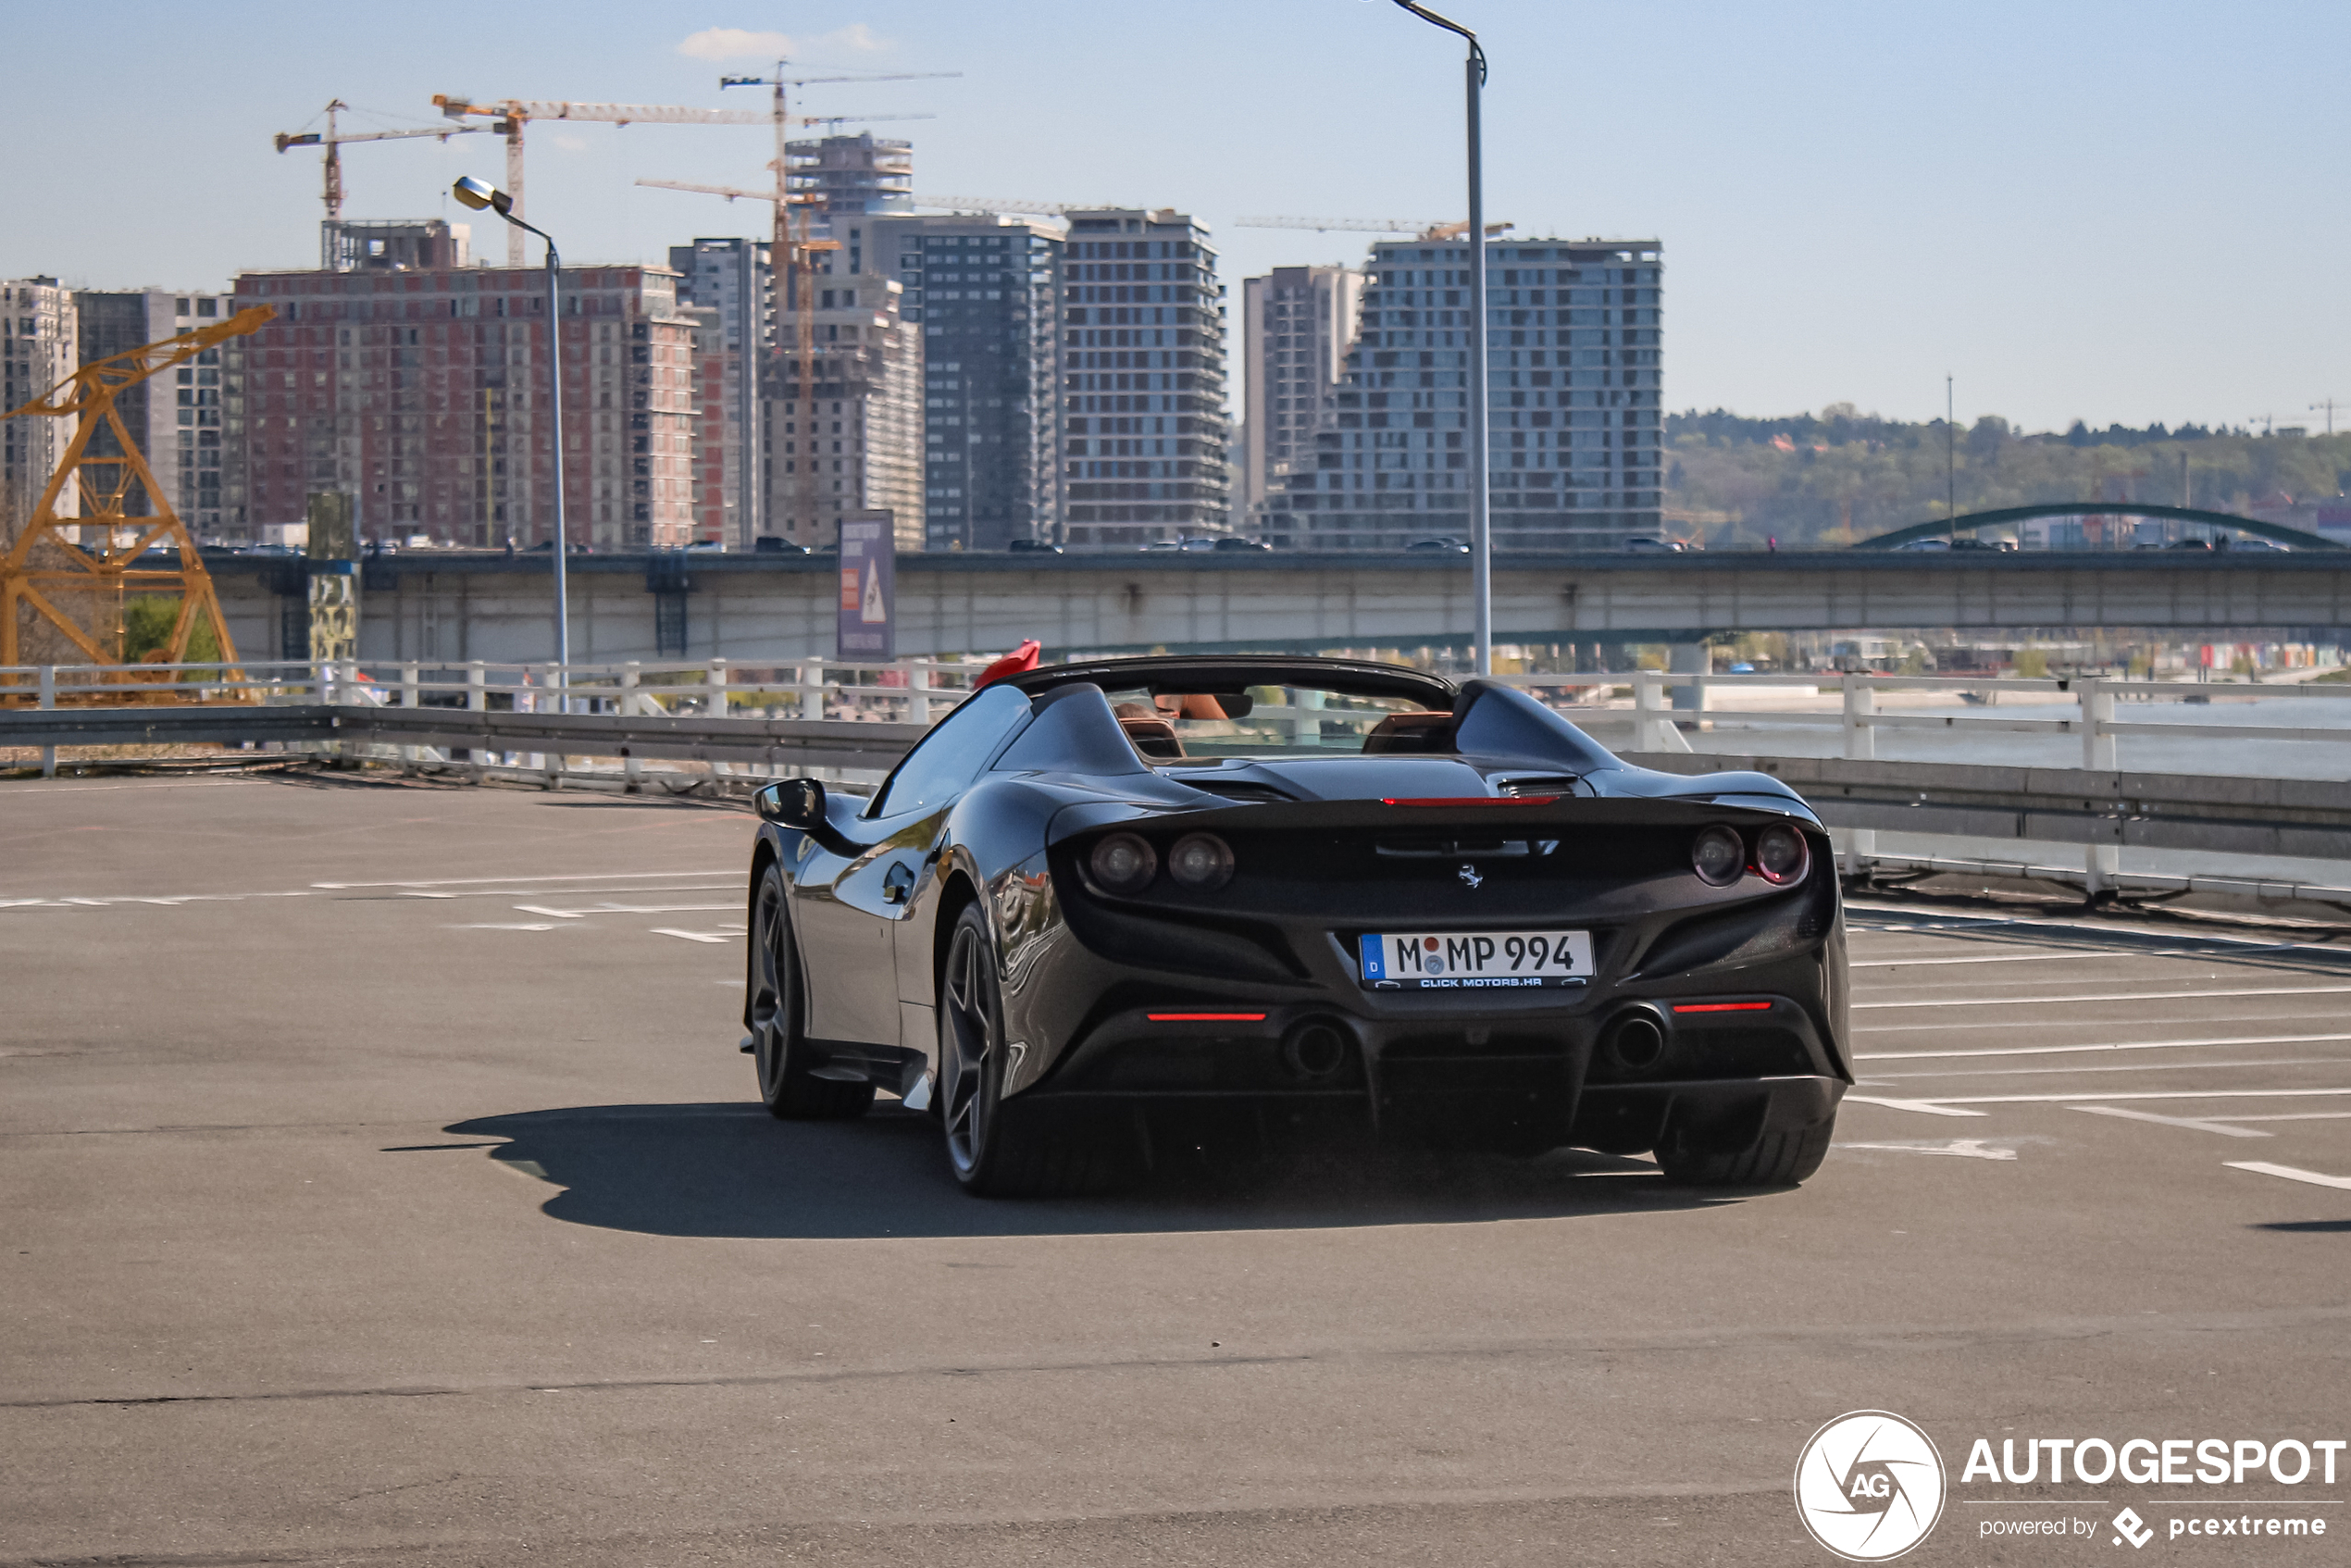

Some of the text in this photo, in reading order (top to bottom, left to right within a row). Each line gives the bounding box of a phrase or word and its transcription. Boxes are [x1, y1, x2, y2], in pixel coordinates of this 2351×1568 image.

[1397, 936, 1574, 972] M MP 994
[1370, 962, 1378, 972] D
[1420, 977, 1543, 988] CLICK MOTORS.HR
